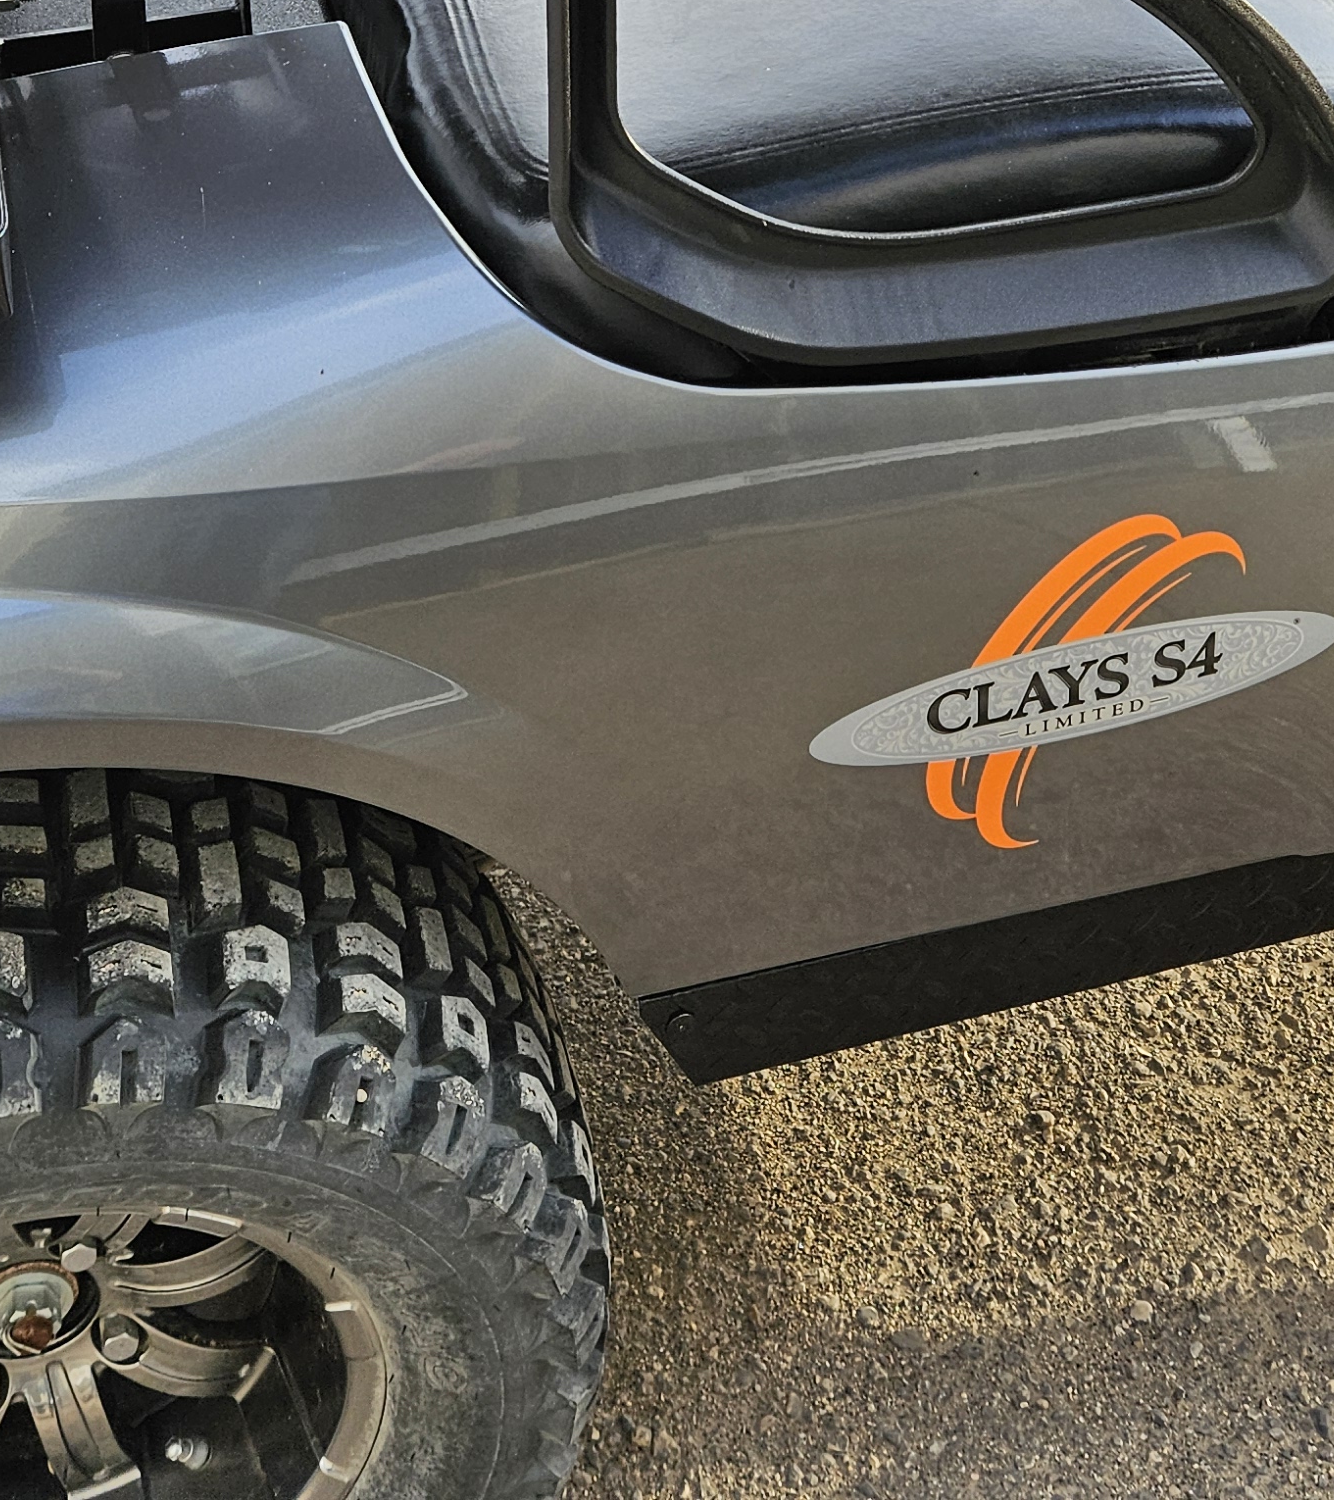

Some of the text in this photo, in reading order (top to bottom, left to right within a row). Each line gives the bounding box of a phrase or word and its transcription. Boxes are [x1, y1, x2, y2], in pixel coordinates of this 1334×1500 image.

[926, 631, 1223, 735] CLAYS S4
[1024, 698, 1145, 737] LIMITED
